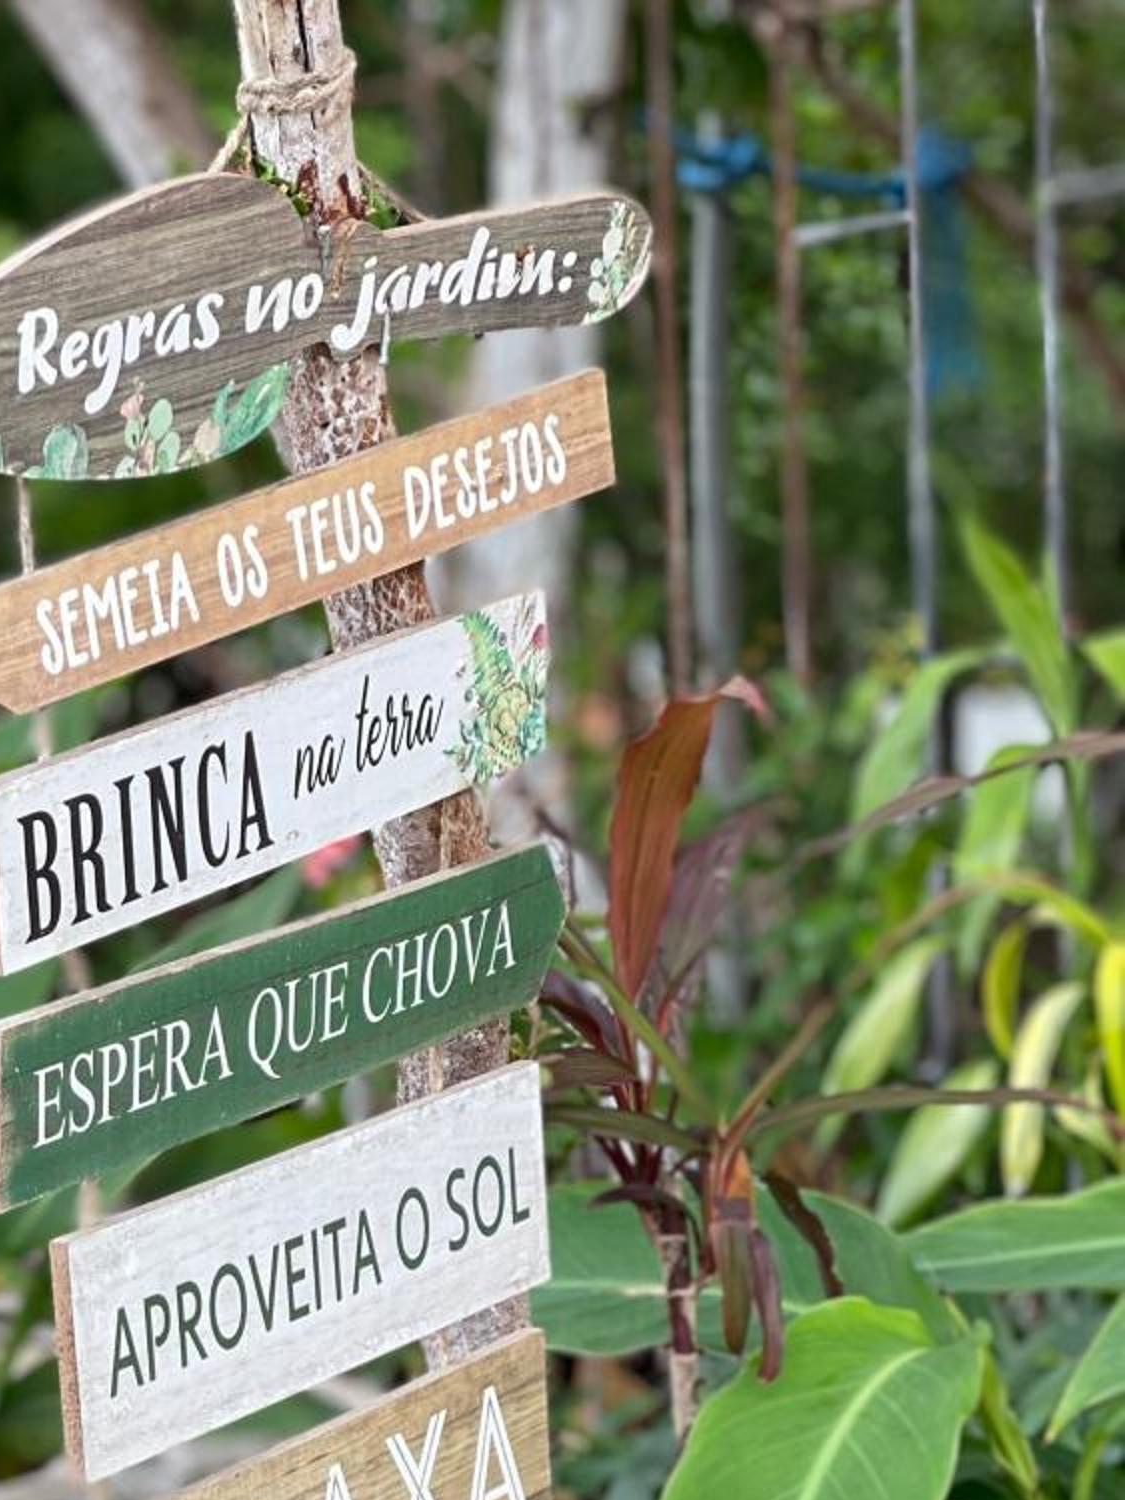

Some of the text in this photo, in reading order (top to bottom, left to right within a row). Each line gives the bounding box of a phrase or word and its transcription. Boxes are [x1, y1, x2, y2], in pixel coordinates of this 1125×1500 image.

[16, 227, 577, 414] Regras no jardim:
[35, 414, 566, 675] SEMEIA OS TEUS DESEJOS
[17, 676, 444, 945] BRINCA na terra
[33, 900, 518, 1149] ESPERA QUE CHOVA
[110, 1148, 530, 1398] APROVEITA O SOL
